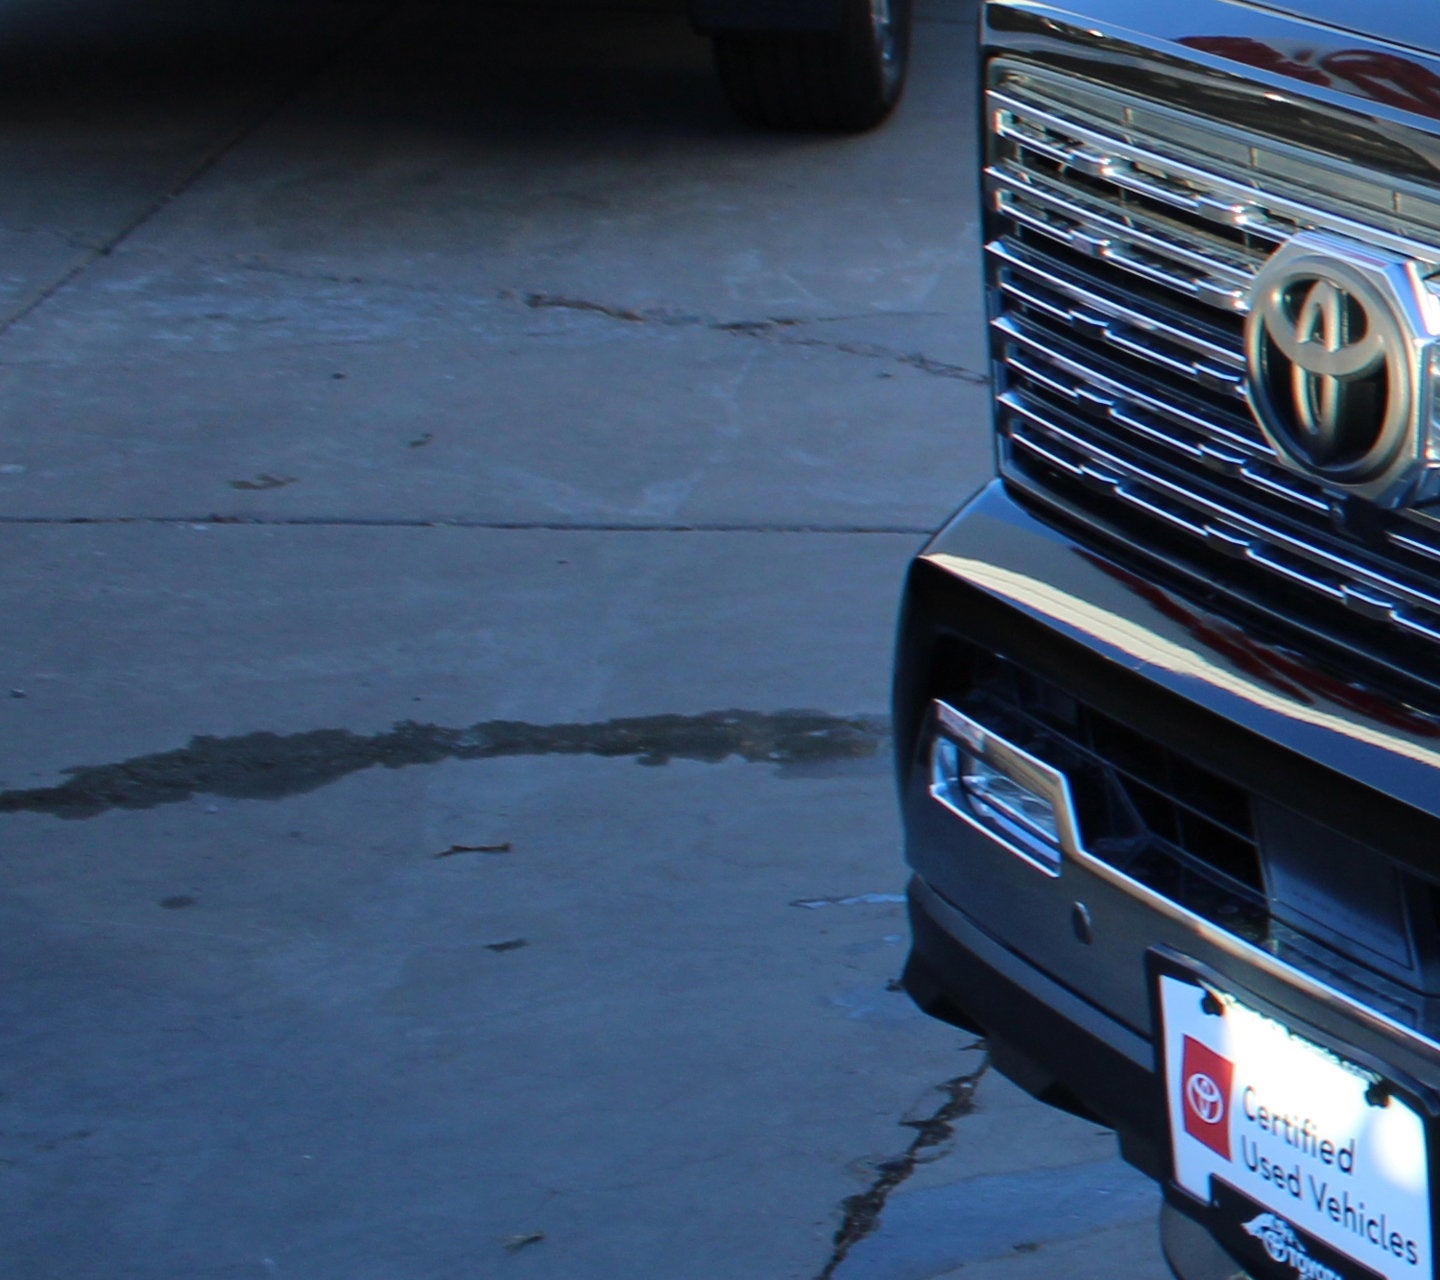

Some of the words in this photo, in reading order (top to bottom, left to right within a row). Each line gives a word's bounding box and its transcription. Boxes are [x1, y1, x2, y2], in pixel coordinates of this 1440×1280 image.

[1242, 1085, 1357, 1177] Certified
[1241, 1135, 1302, 1199] Used
[1309, 1176, 1419, 1266] Vehicles
